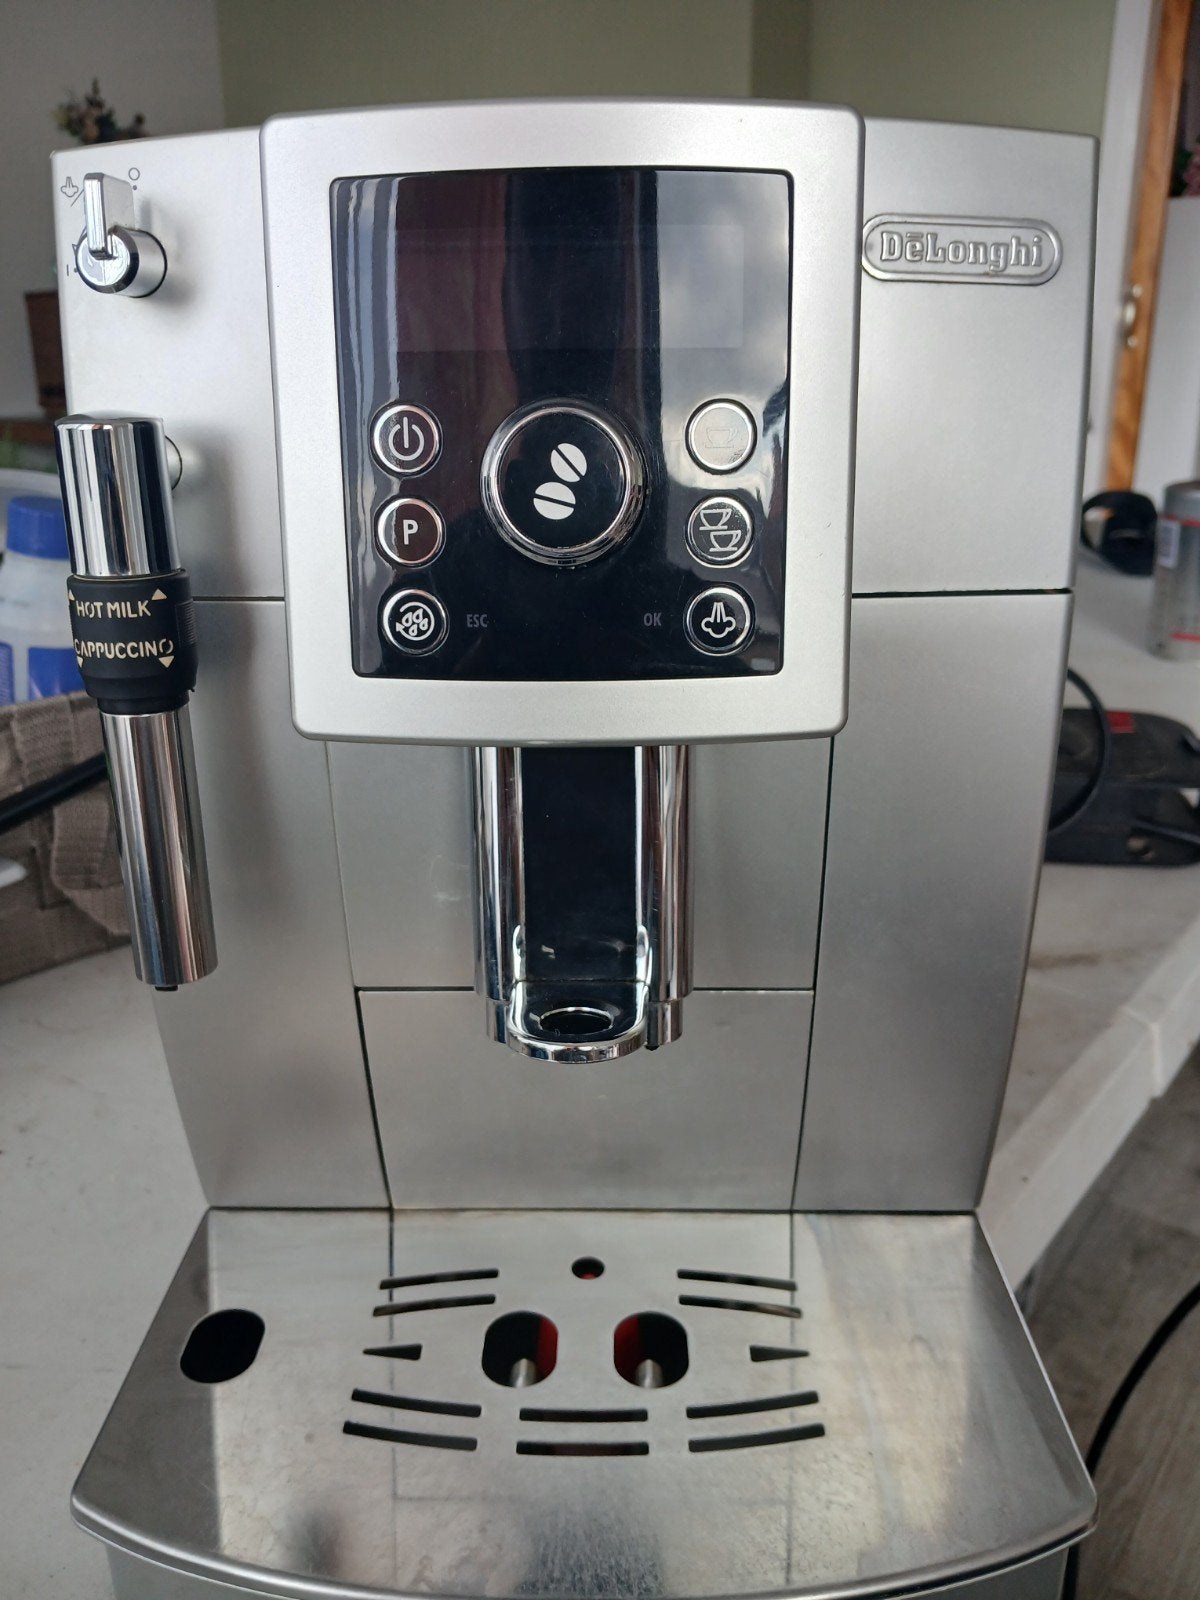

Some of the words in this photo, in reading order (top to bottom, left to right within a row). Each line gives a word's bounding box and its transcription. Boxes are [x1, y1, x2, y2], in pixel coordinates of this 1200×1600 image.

[402, 519, 419, 546] P
[75, 600, 103, 619] HOT
[106, 600, 151, 619] MILK
[466, 613, 488, 628] ESC
[643, 612, 662, 627] OK
[74, 638, 174, 659] CAPPUCCINO
